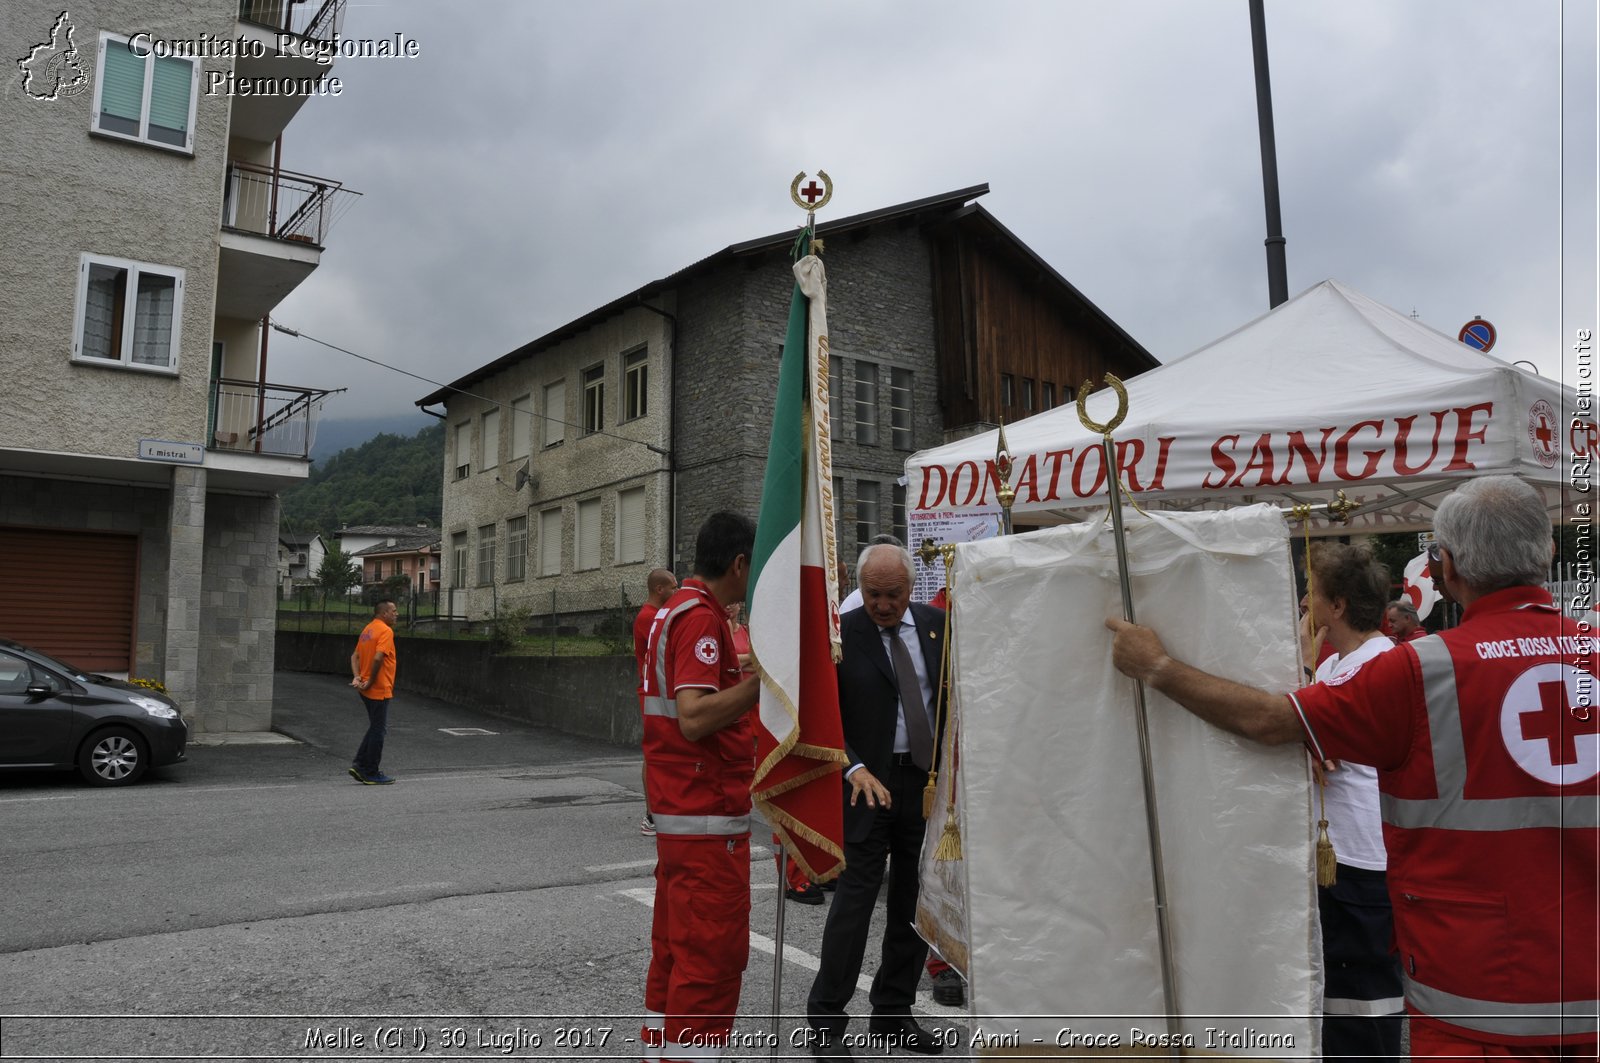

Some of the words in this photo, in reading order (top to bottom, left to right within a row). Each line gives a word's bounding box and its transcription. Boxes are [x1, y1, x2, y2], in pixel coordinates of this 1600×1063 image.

[156, 449, 187, 458] mistral
[915, 436, 1177, 511] DONATORI
[1475, 639, 1521, 660] CROCE
[1515, 636, 1561, 657] ROSSA
